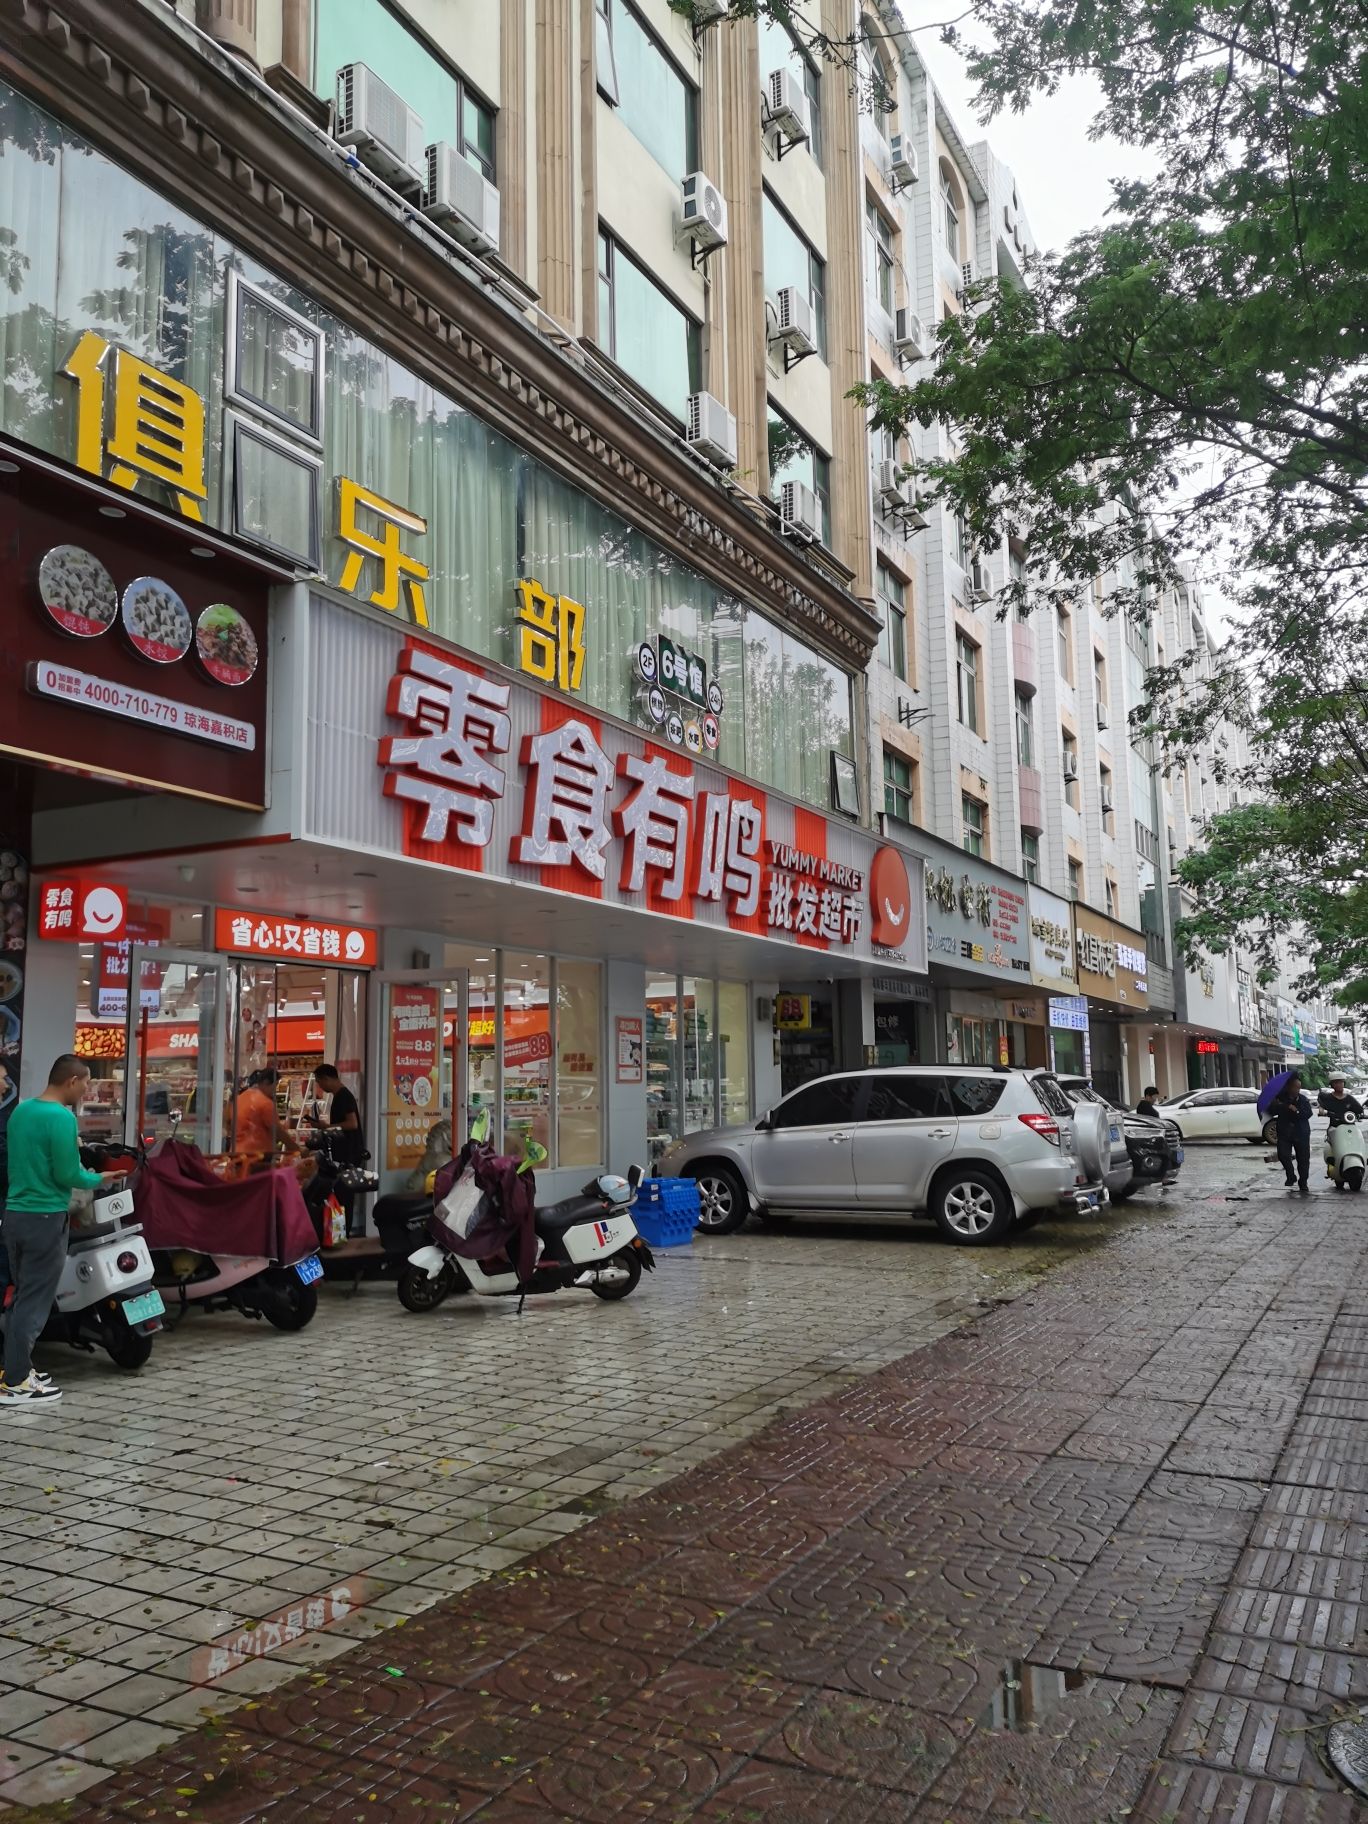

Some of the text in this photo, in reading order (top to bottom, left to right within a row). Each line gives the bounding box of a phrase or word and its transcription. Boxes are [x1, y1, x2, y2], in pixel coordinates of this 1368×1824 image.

[642, 654, 654, 669] 2F
[662, 649, 703, 697] 6号馆
[84, 682, 178, 723] 4000-710-779
[184, 711, 249, 744] 琼海嘉积店
[379, 648, 763, 918] 零食有鸣
[769, 841, 866, 891] YUMMY MARKET
[45, 888, 74, 909] 零食
[766, 871, 865, 944] 批发超市
[231, 917, 341, 957] 省心!又省钱
